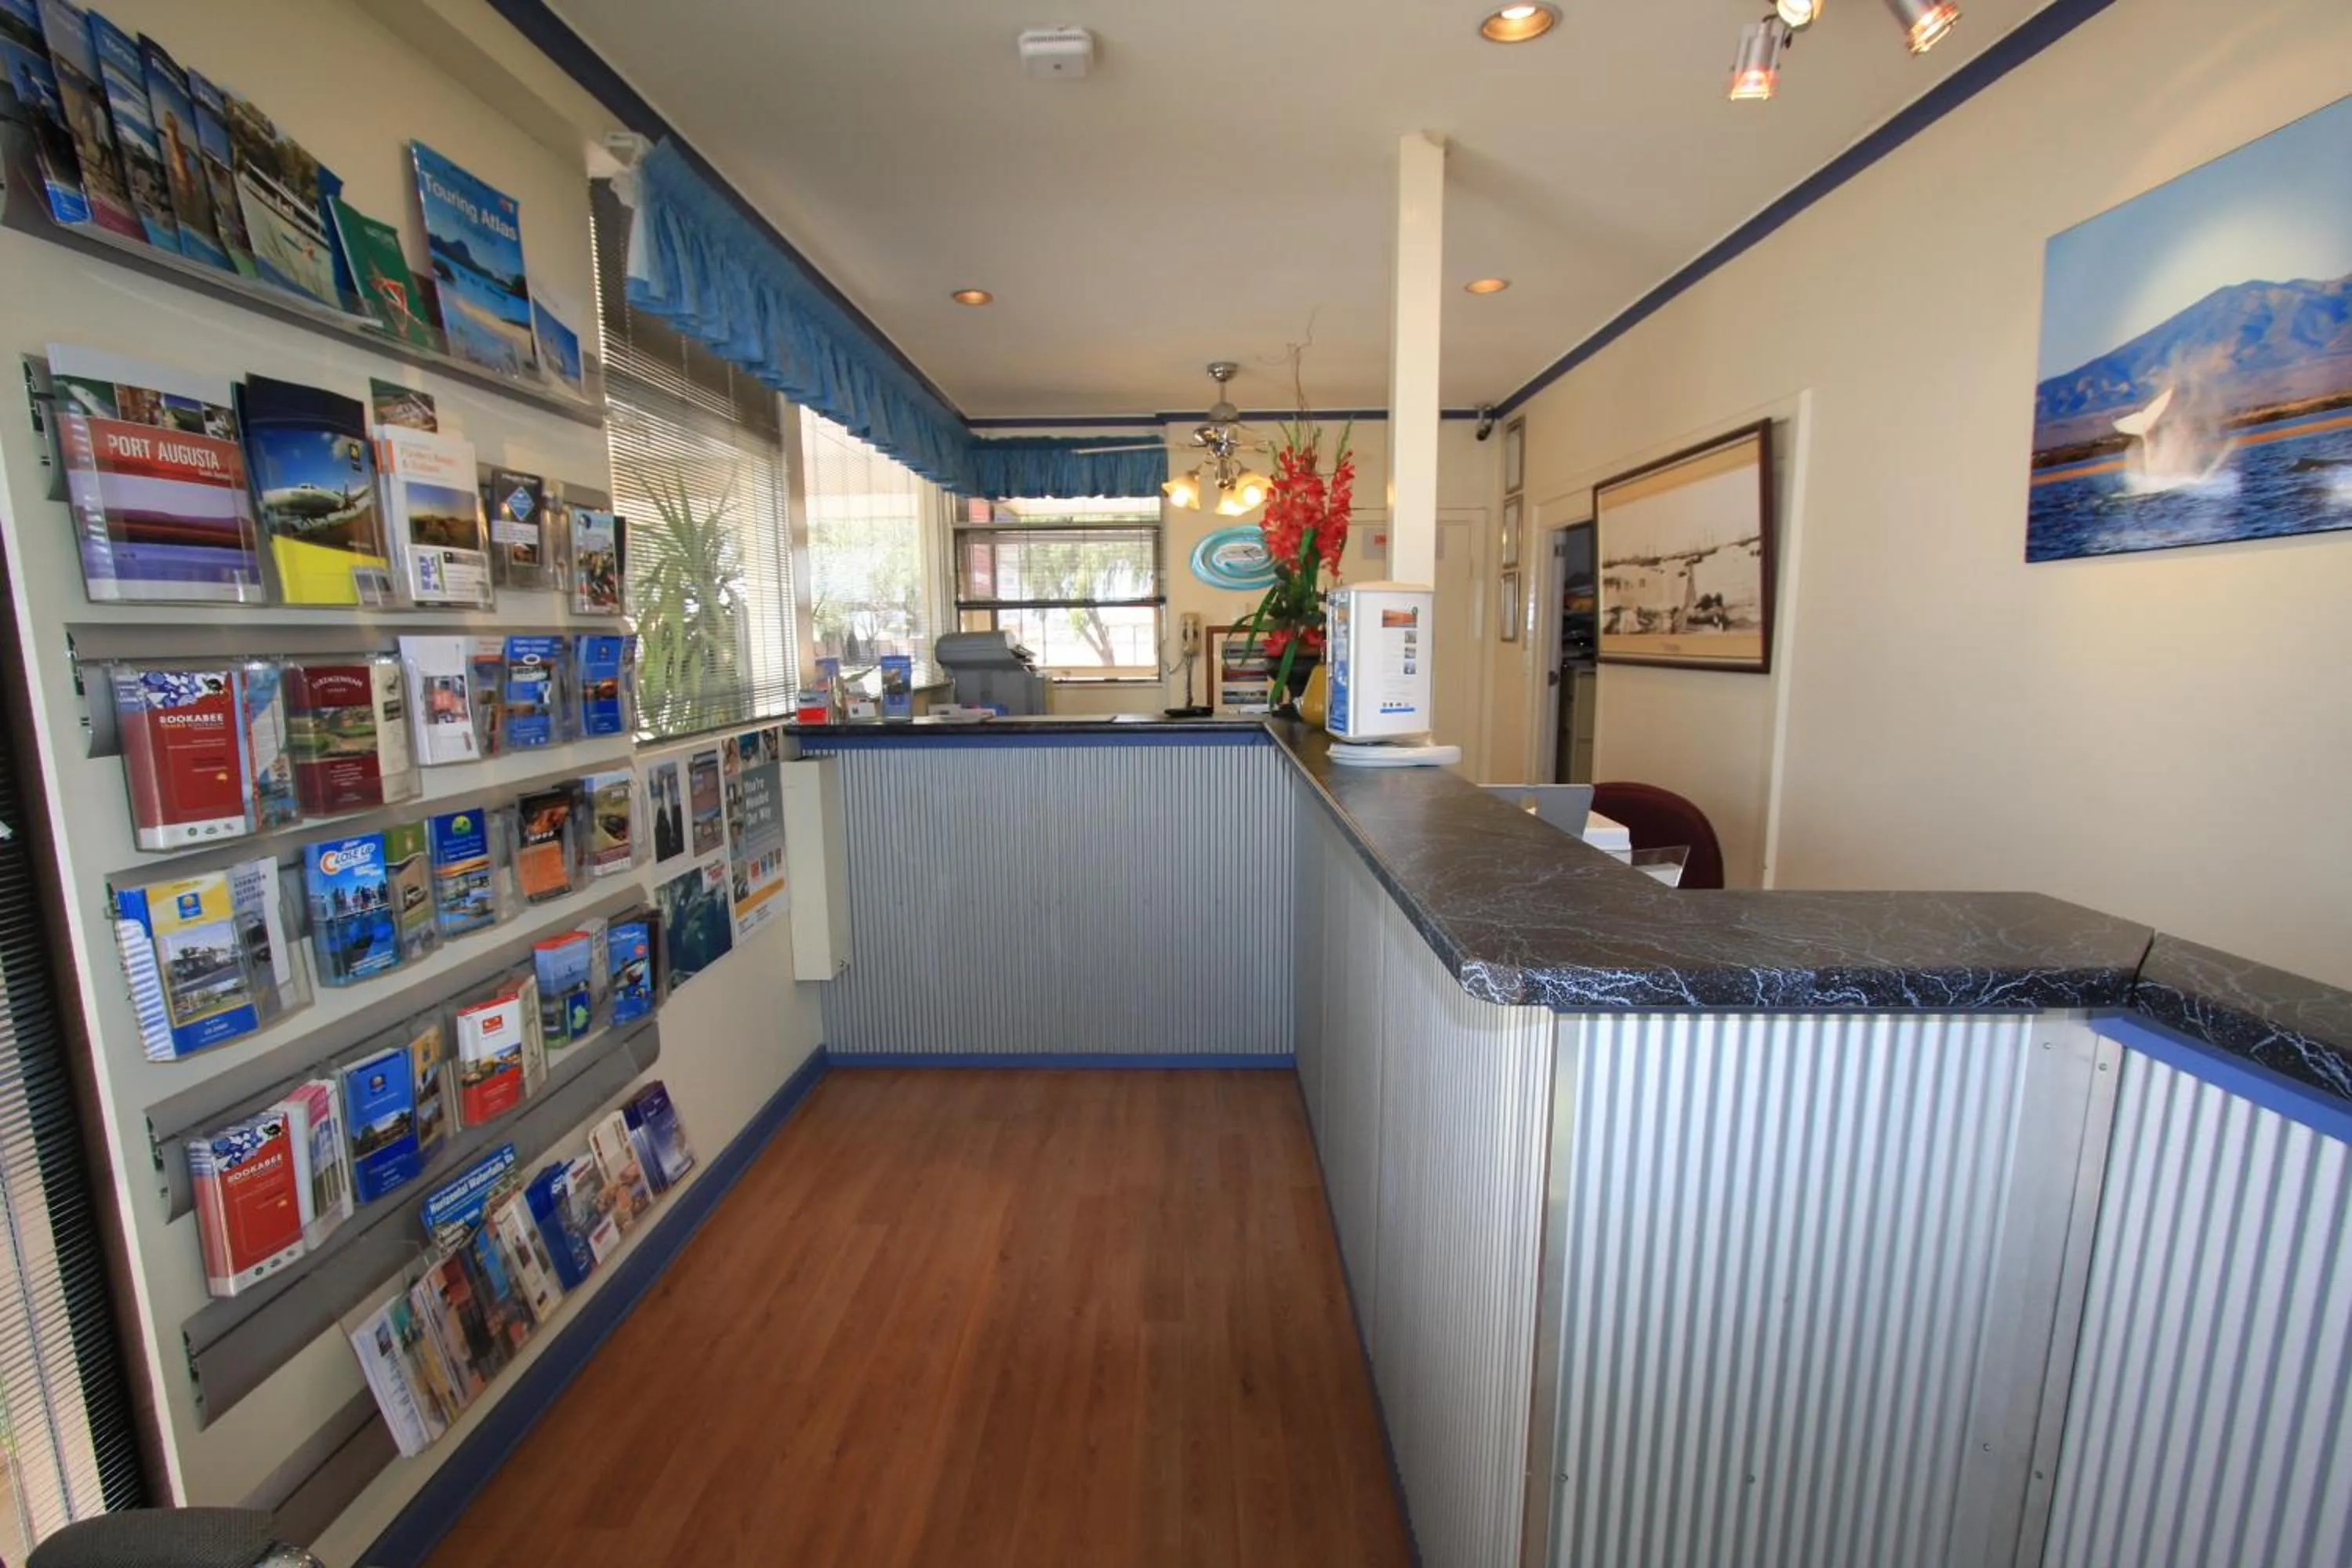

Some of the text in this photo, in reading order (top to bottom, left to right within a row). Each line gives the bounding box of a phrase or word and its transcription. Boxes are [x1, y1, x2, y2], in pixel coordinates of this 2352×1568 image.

[422, 170, 517, 241] Touring Atlas
[107, 434, 220, 470] PORT AUGUSTA
[158, 713, 223, 724] BOOKABEE
[227, 1153, 282, 1183] BOOKABEE
